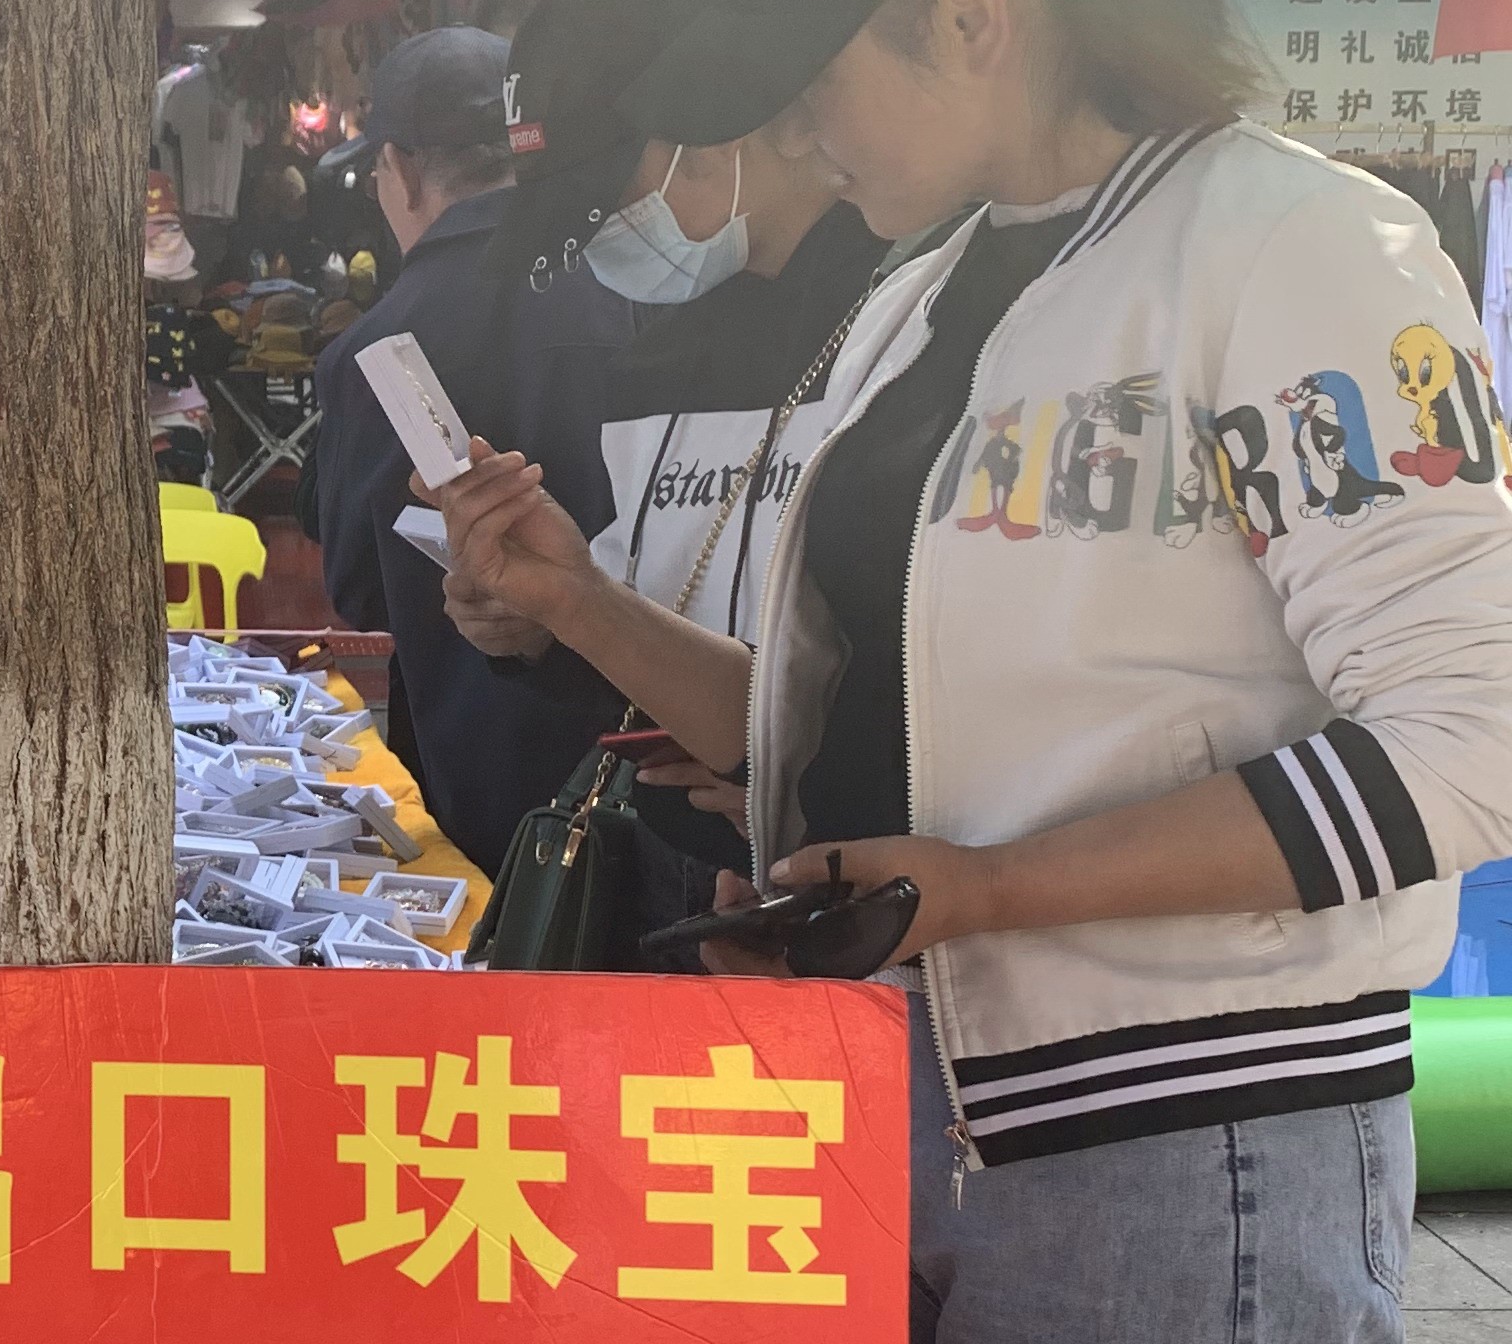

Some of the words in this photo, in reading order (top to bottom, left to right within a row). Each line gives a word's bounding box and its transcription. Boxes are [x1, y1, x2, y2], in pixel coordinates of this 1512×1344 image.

[1287, 29, 1482, 64] 明礼诚
[1284, 88, 1482, 123] 保护环境
